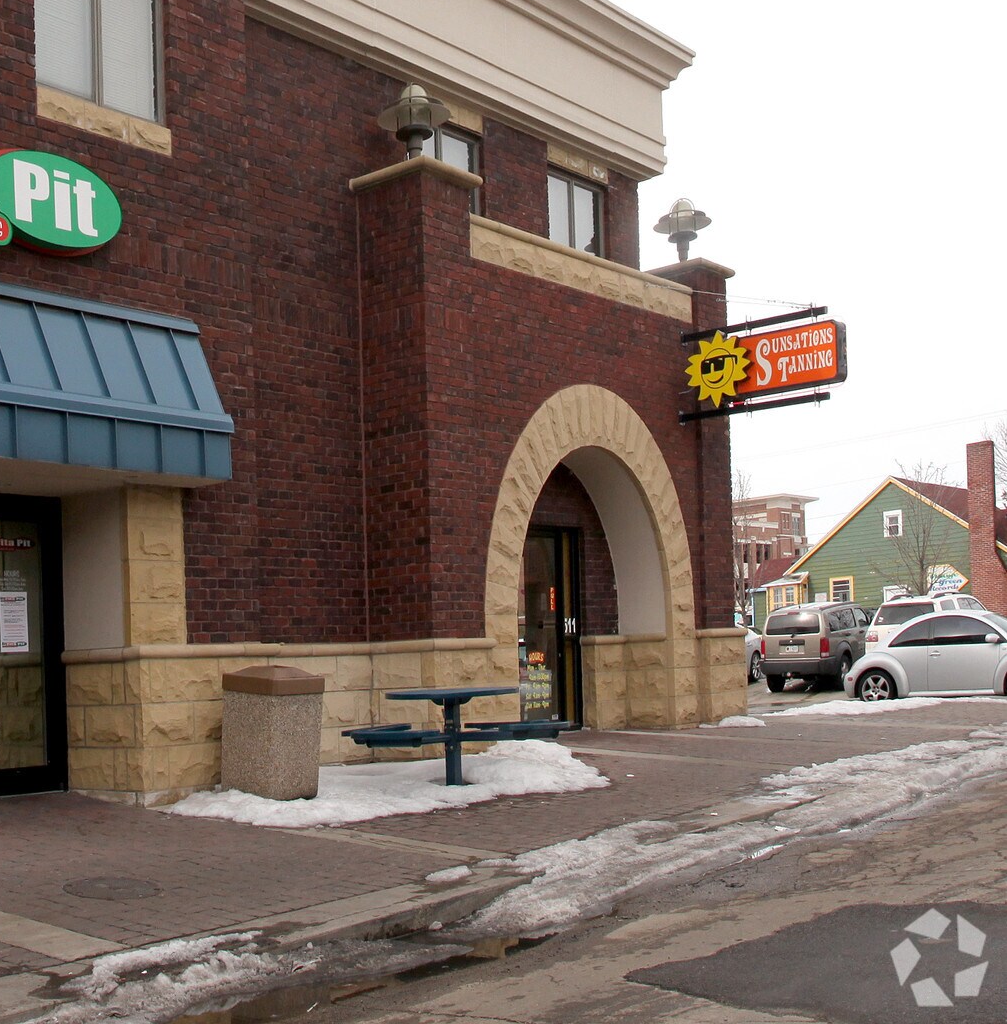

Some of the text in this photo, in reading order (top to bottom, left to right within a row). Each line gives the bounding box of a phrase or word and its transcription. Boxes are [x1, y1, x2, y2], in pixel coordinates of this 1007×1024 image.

[13, 158, 98, 238] Pit
[755, 327, 833, 387] SUNSATIONS
[777, 349, 833, 383] TANNING
[17, 539, 31, 547] Pit
[529, 652, 544, 662] HOURS
